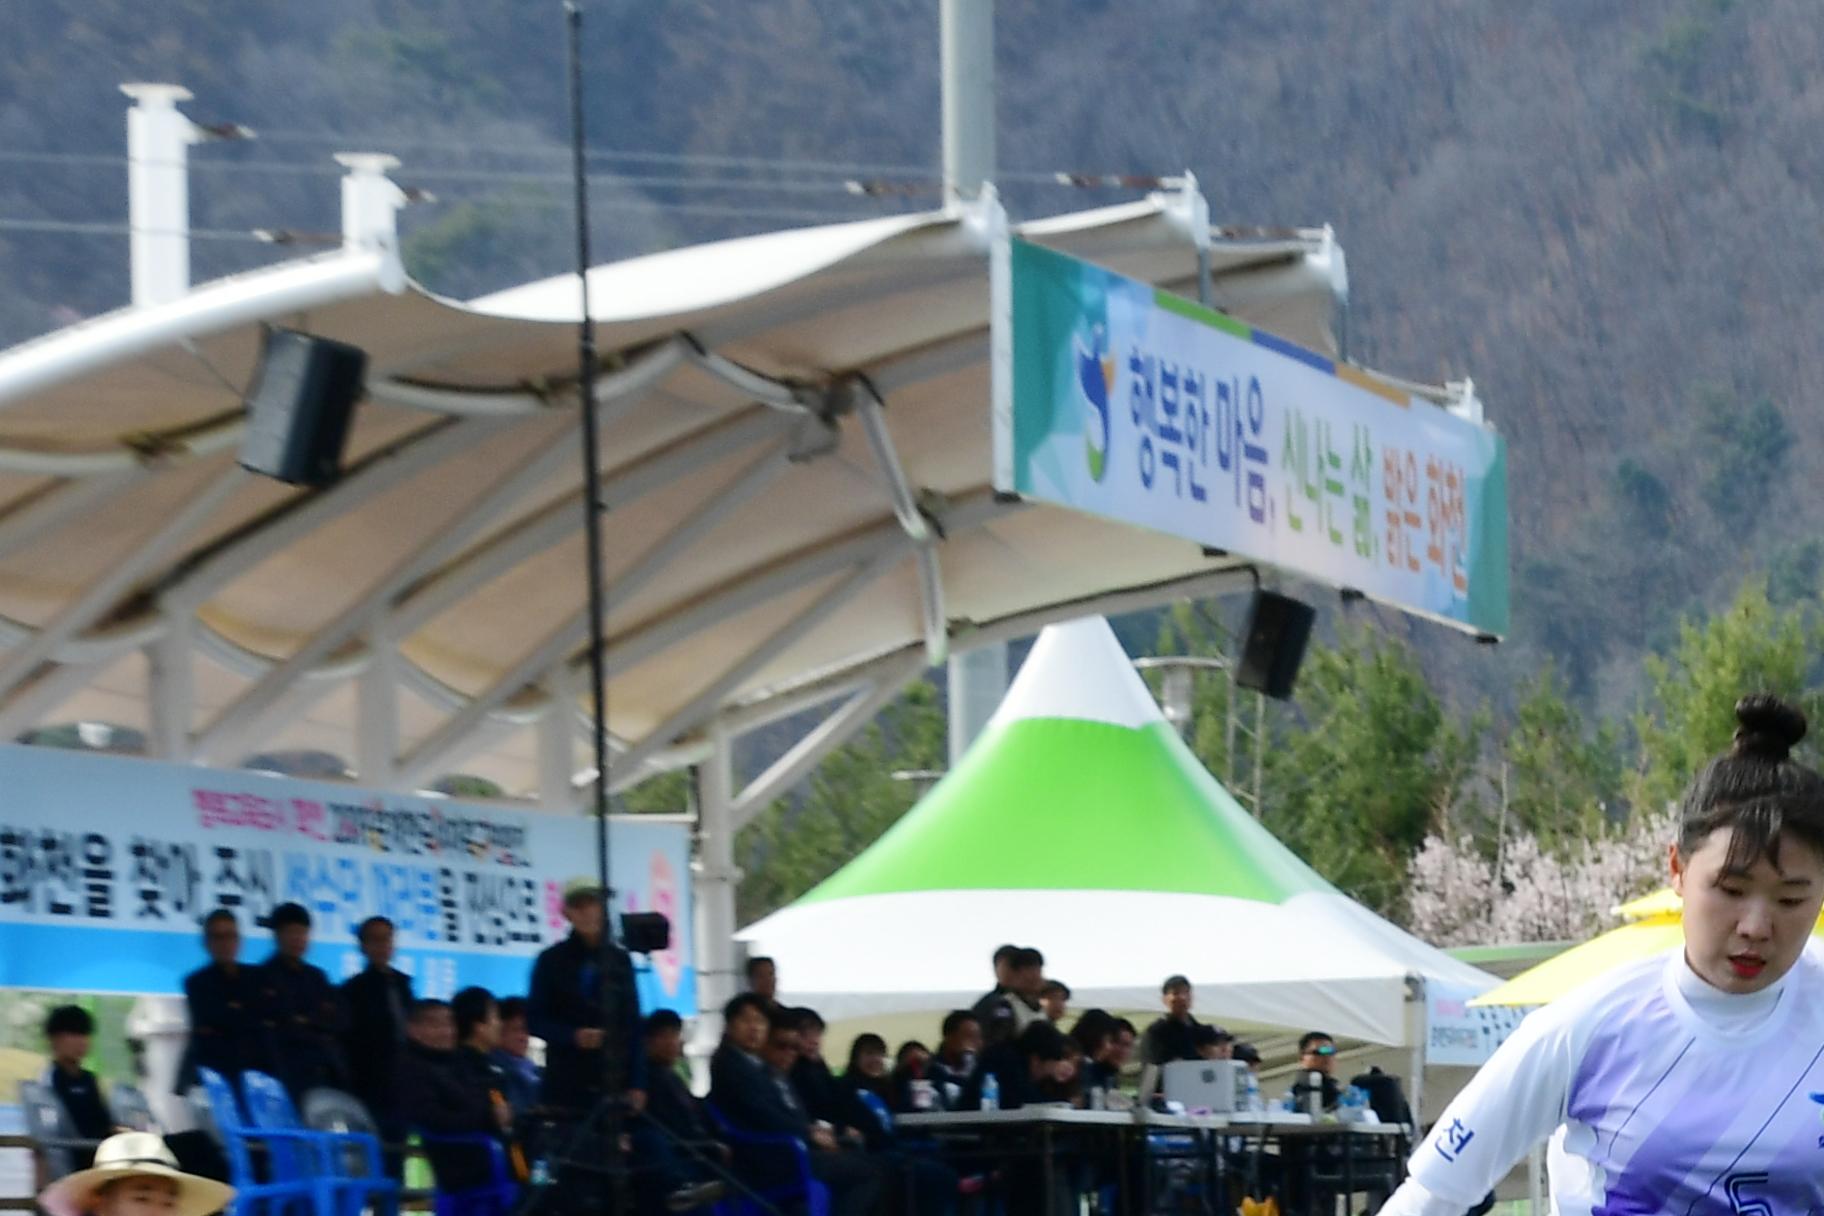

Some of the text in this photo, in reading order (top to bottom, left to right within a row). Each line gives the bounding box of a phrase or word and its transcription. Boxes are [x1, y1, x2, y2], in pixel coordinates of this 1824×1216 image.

[1128, 345, 1208, 503] 행복한
[1281, 408, 1344, 546] 신나는
[1383, 446, 1421, 574] 밝은
[1426, 453, 1468, 593] 화천
